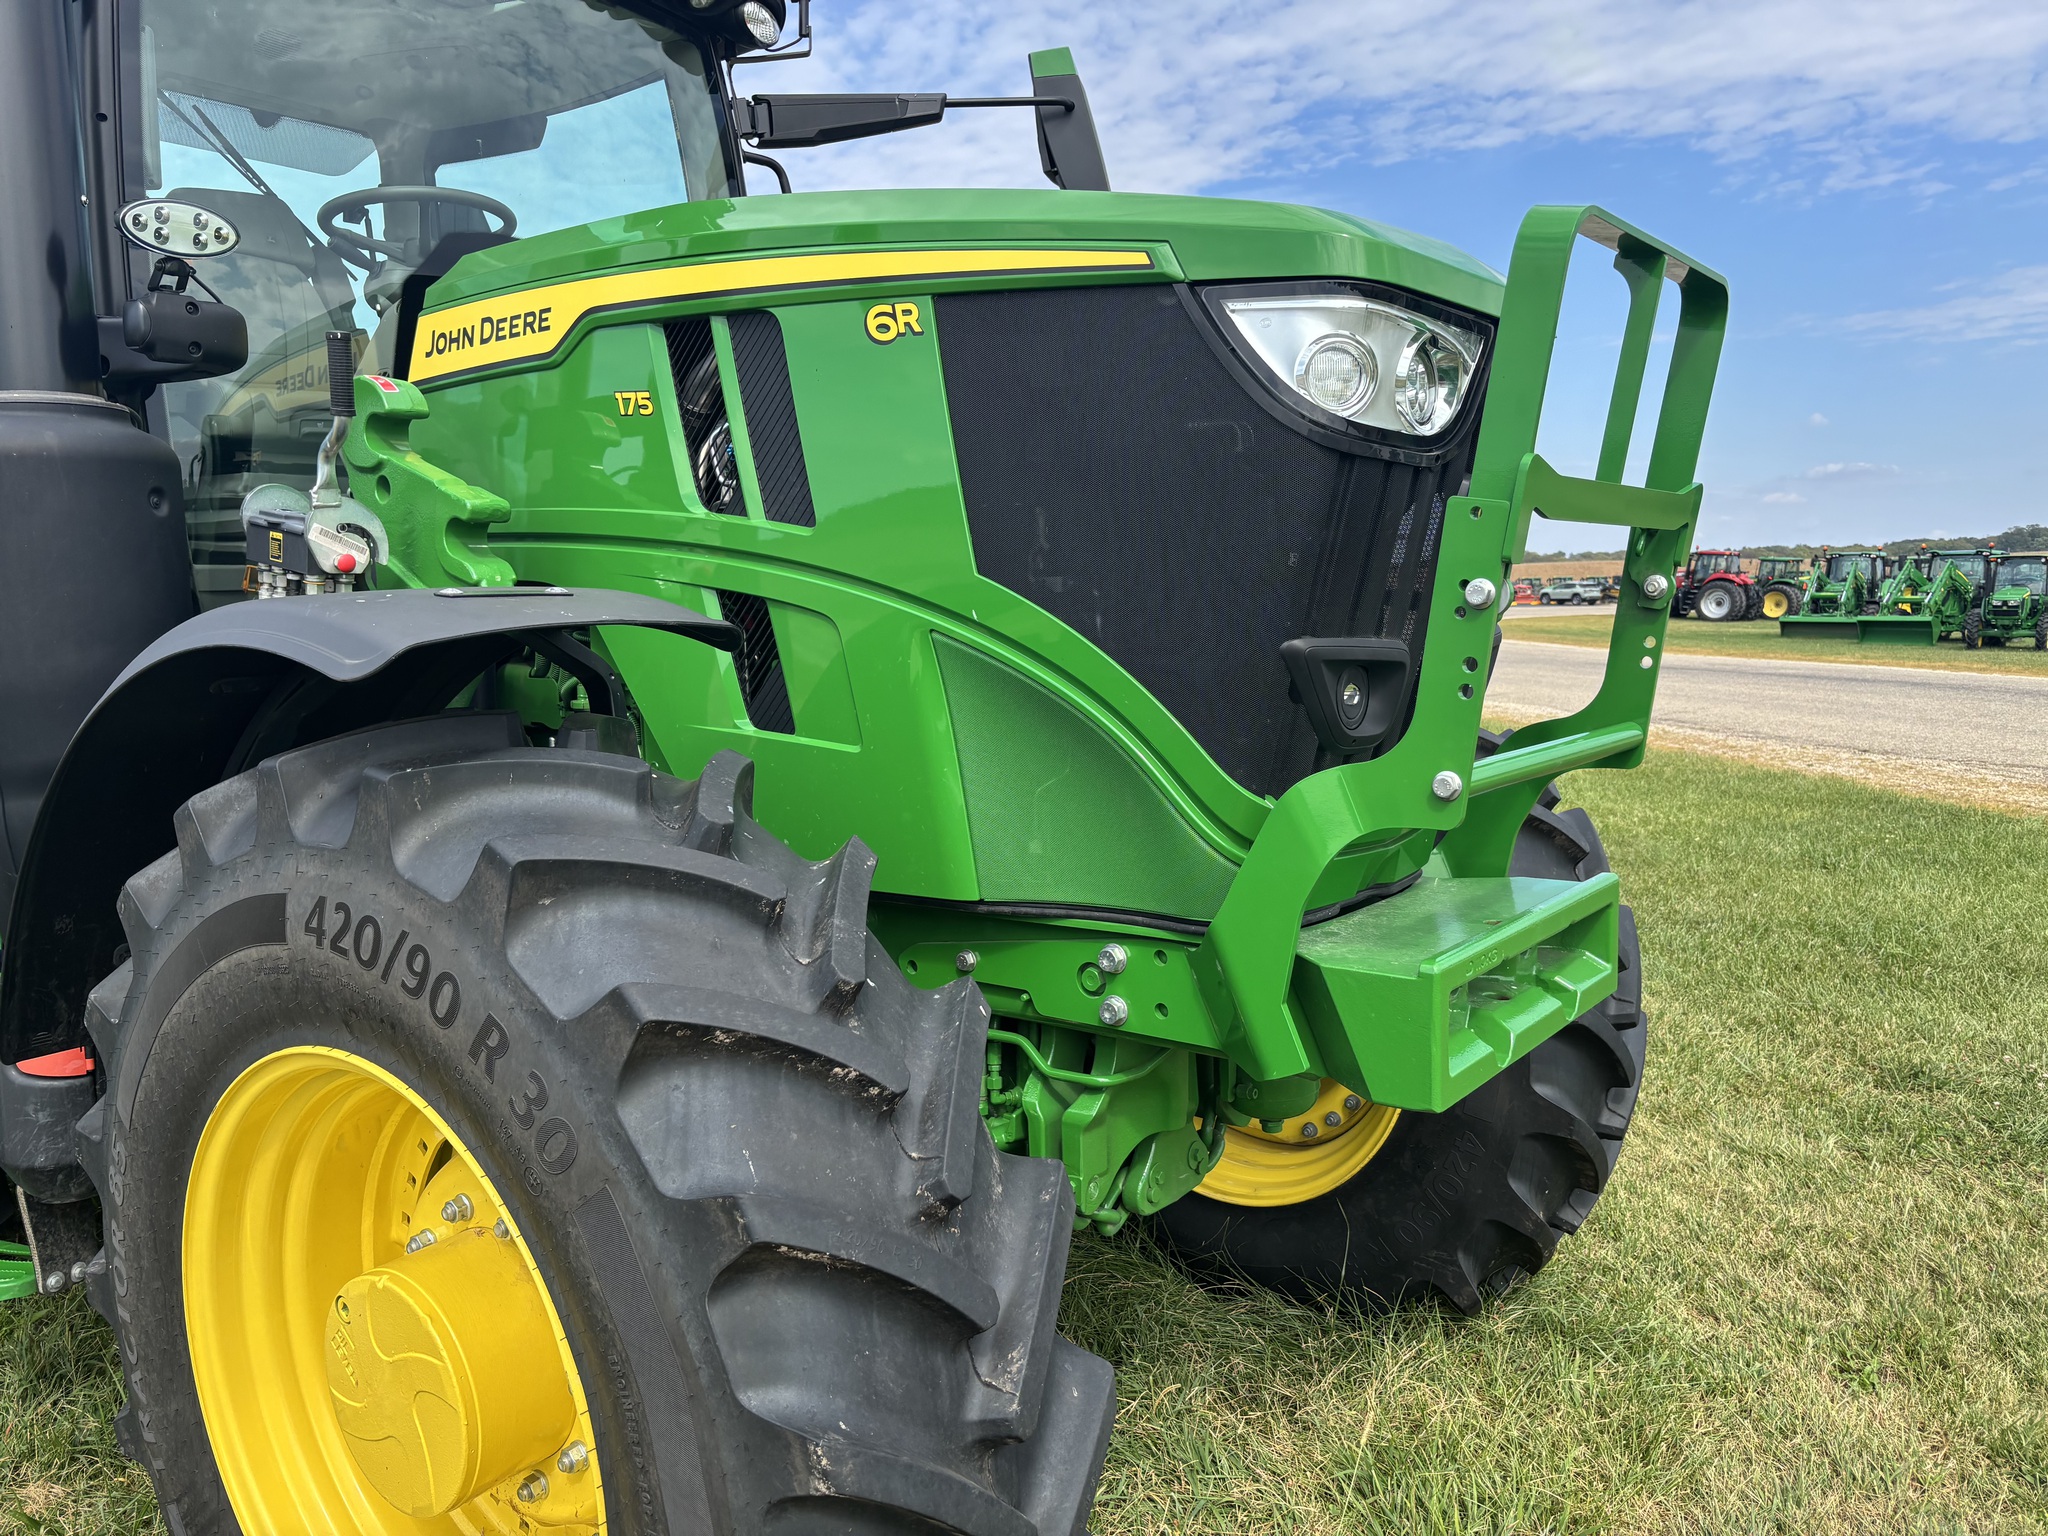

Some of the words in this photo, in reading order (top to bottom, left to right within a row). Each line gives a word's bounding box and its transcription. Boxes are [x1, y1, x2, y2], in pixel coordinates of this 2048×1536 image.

[425, 325, 475, 358] JOHN
[480, 307, 551, 345] DEERE
[864, 301, 924, 345] 6R
[614, 391, 654, 416] 175
[304, 895, 461, 1029] 420/90
[467, 1011, 510, 1084] R
[508, 1069, 578, 1175] 30
[108, 1129, 127, 1207] 85
[1394, 1130, 1486, 1248] 420/90
[111, 1218, 166, 1479] TRACTOR
[607, 1353, 645, 1470] ENGINEERED
